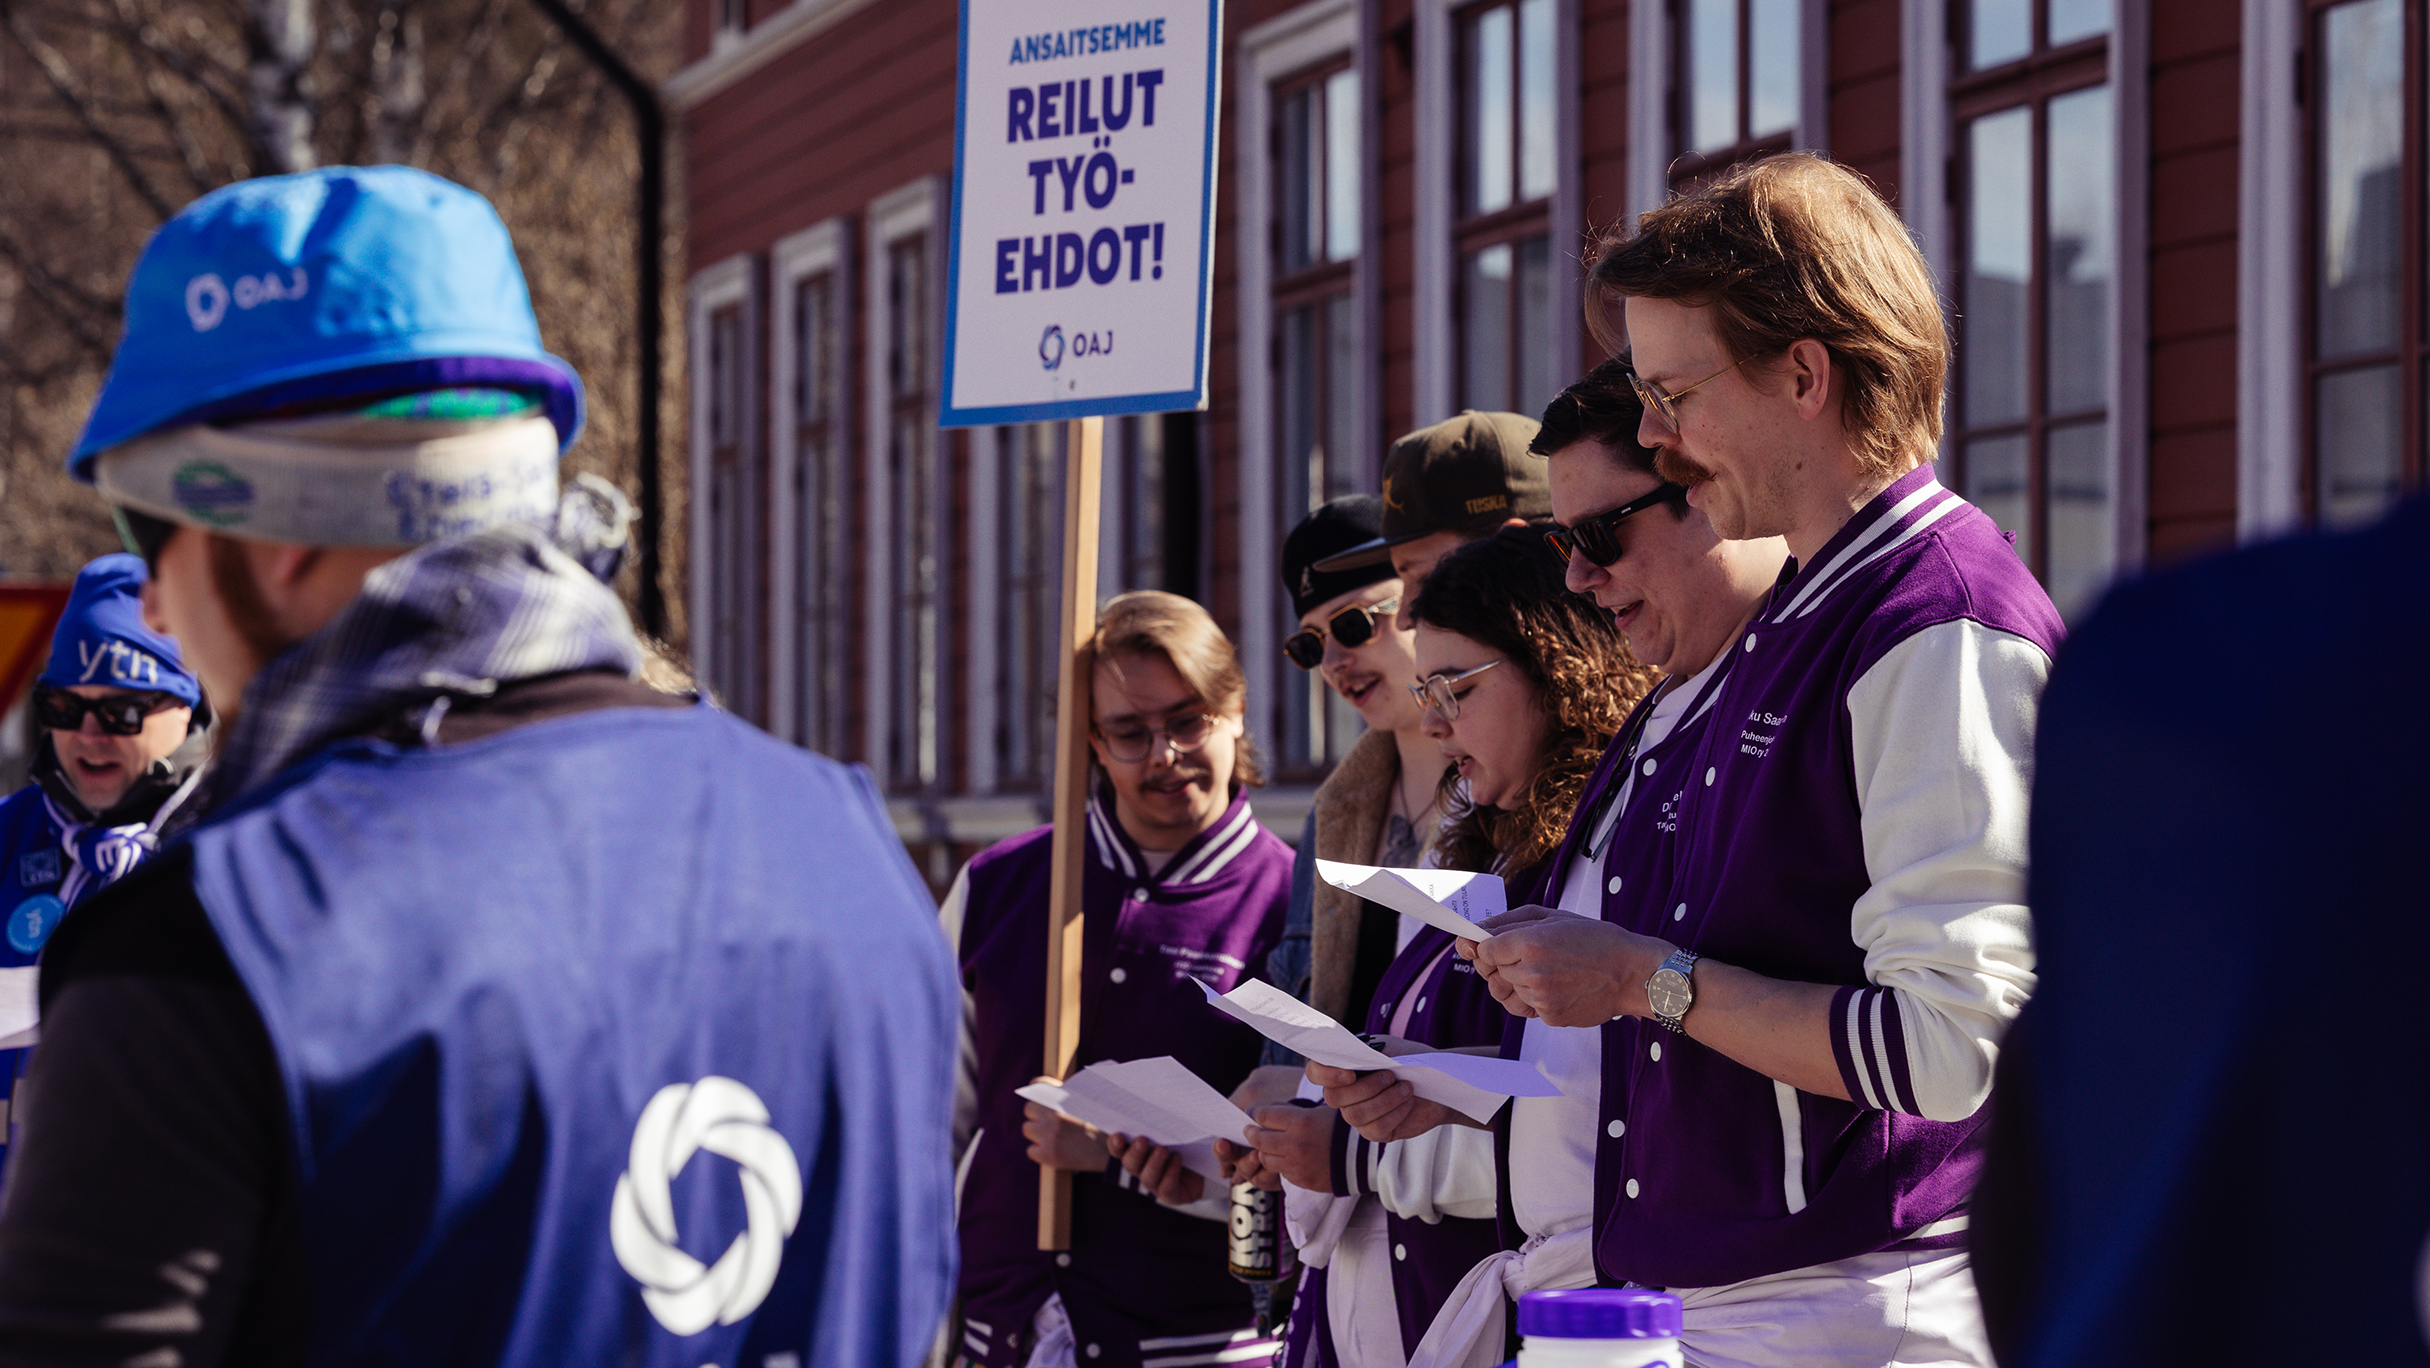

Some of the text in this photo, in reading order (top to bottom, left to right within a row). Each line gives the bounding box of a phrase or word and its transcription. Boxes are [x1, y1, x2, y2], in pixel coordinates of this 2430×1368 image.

[1009, 17, 1166, 66] ANSAITSEMME
[1007, 69, 1164, 144] REILUT
[1028, 135, 1135, 216] TYÖ-
[995, 222, 1165, 295] EHDOT!
[232, 266, 309, 311] OAJ
[1072, 330, 1114, 357] OAJ
[1465, 494, 1508, 515] TUSKA
[78, 639, 159, 686] ytn
[1741, 744, 1757, 755] MIO
[1251, 1188, 1273, 1269] STRO
